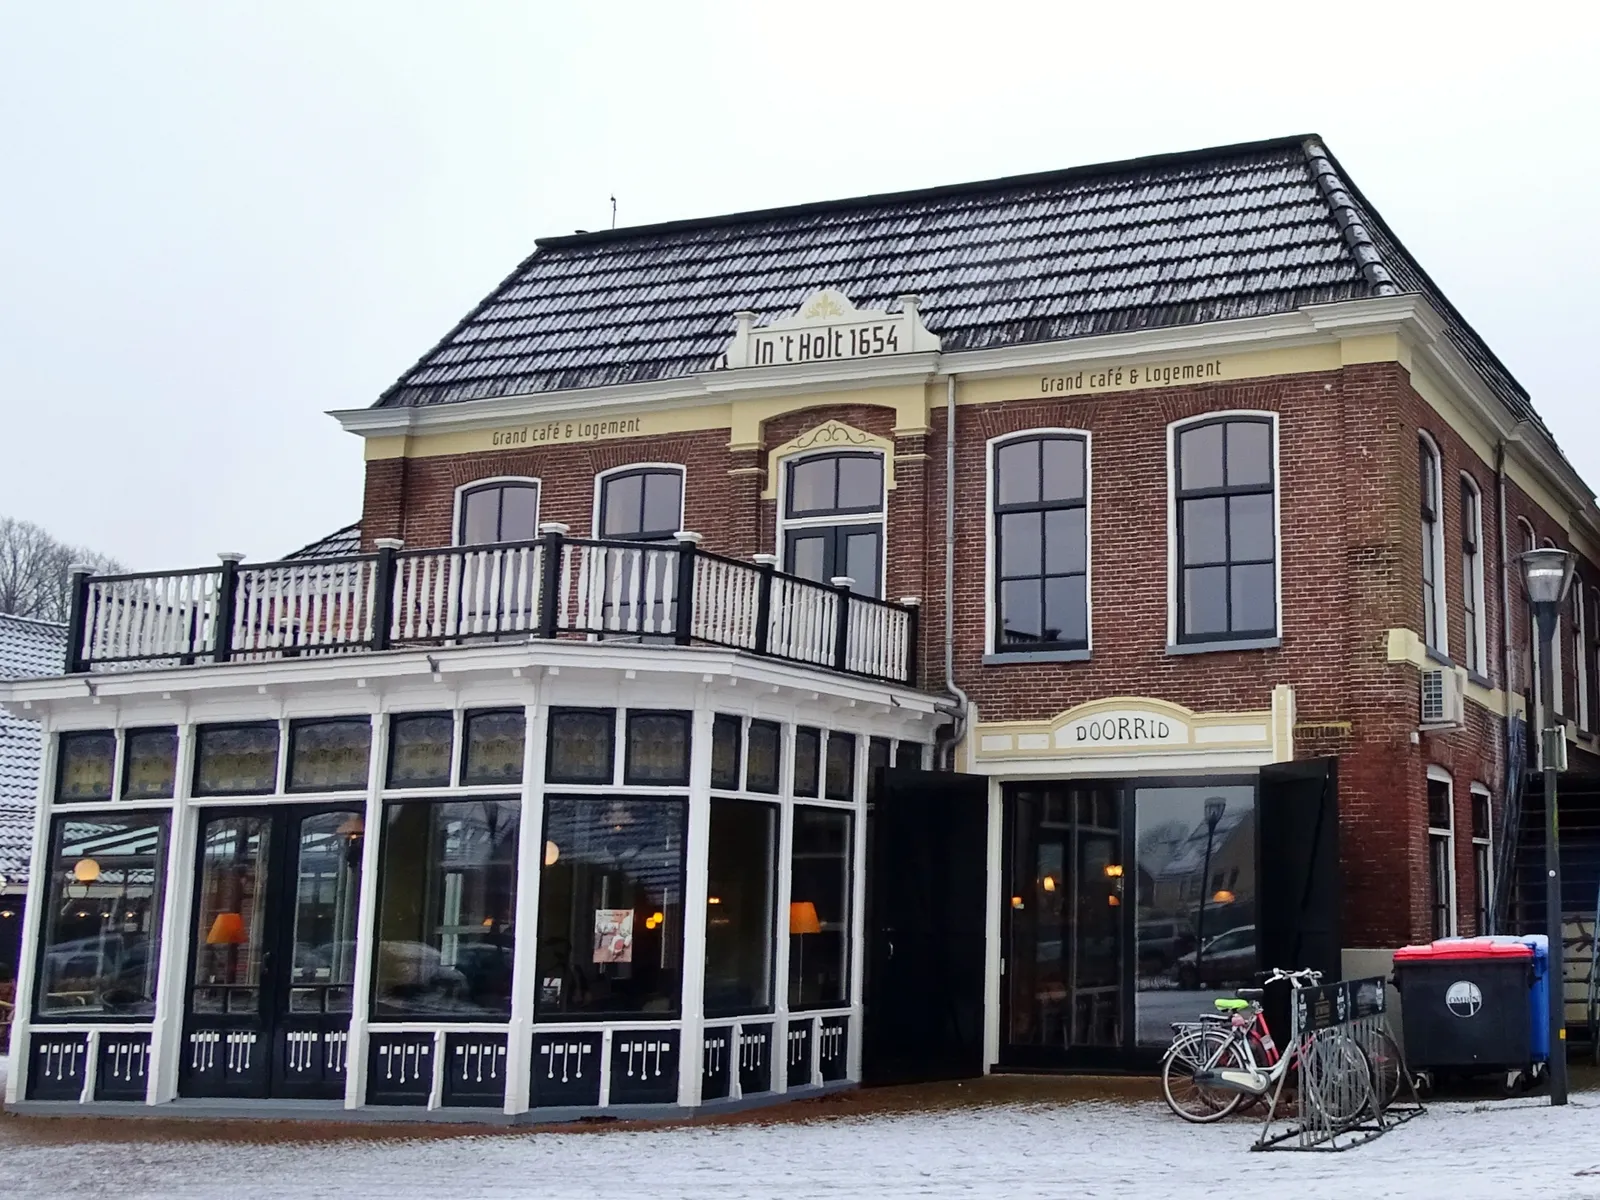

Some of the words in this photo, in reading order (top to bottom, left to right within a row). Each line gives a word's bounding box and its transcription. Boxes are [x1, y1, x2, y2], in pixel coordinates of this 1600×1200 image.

[755, 338, 774, 365] In
[798, 327, 843, 361] Holt
[850, 324, 898, 356] 1654
[1041, 371, 1083, 392] Grand
[1090, 366, 1122, 388] café
[1129, 369, 1139, 384] &
[1145, 360, 1222, 385] Logement
[492, 427, 527, 446] Grand
[532, 422, 560, 441] café
[565, 424, 573, 438] &
[578, 417, 640, 440] Logement
[1076, 717, 1170, 741] DOORRID
